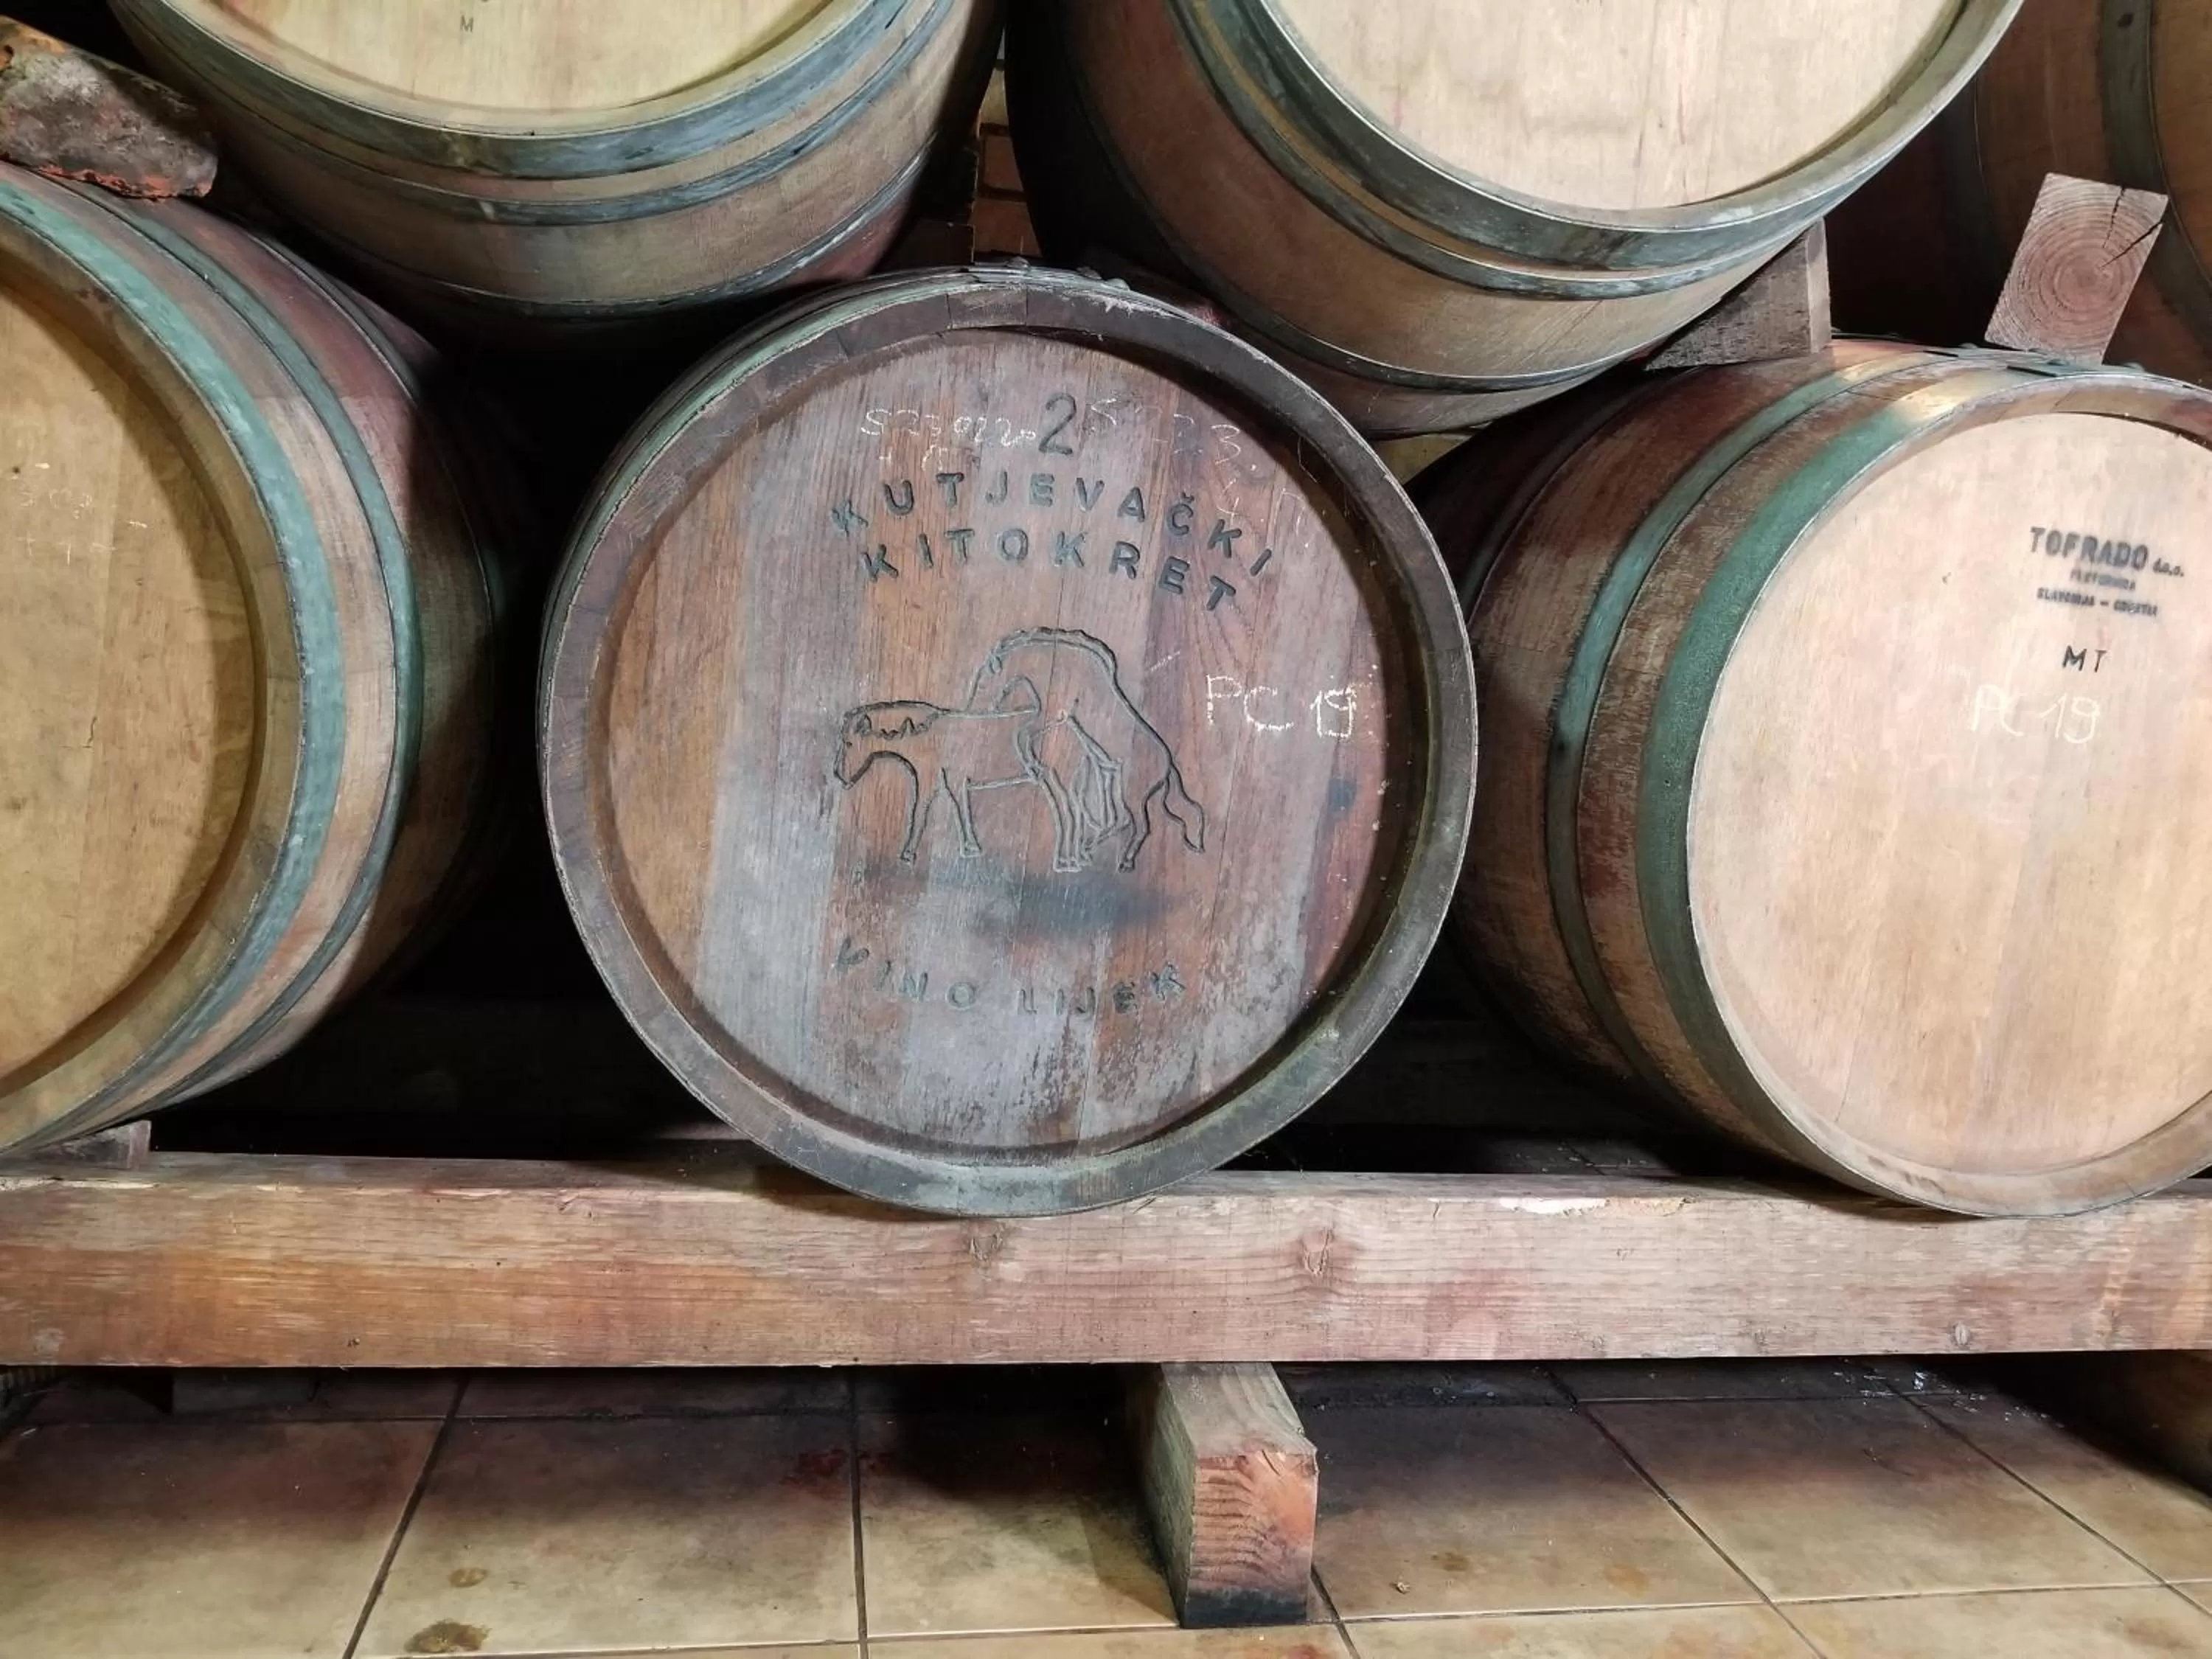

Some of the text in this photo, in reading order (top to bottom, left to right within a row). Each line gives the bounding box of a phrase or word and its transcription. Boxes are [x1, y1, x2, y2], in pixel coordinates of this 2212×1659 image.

[1038, 392, 1077, 456] 2
[830, 470, 1273, 577] KUTJEVAČKI
[860, 527, 1236, 611] KITOKRET
